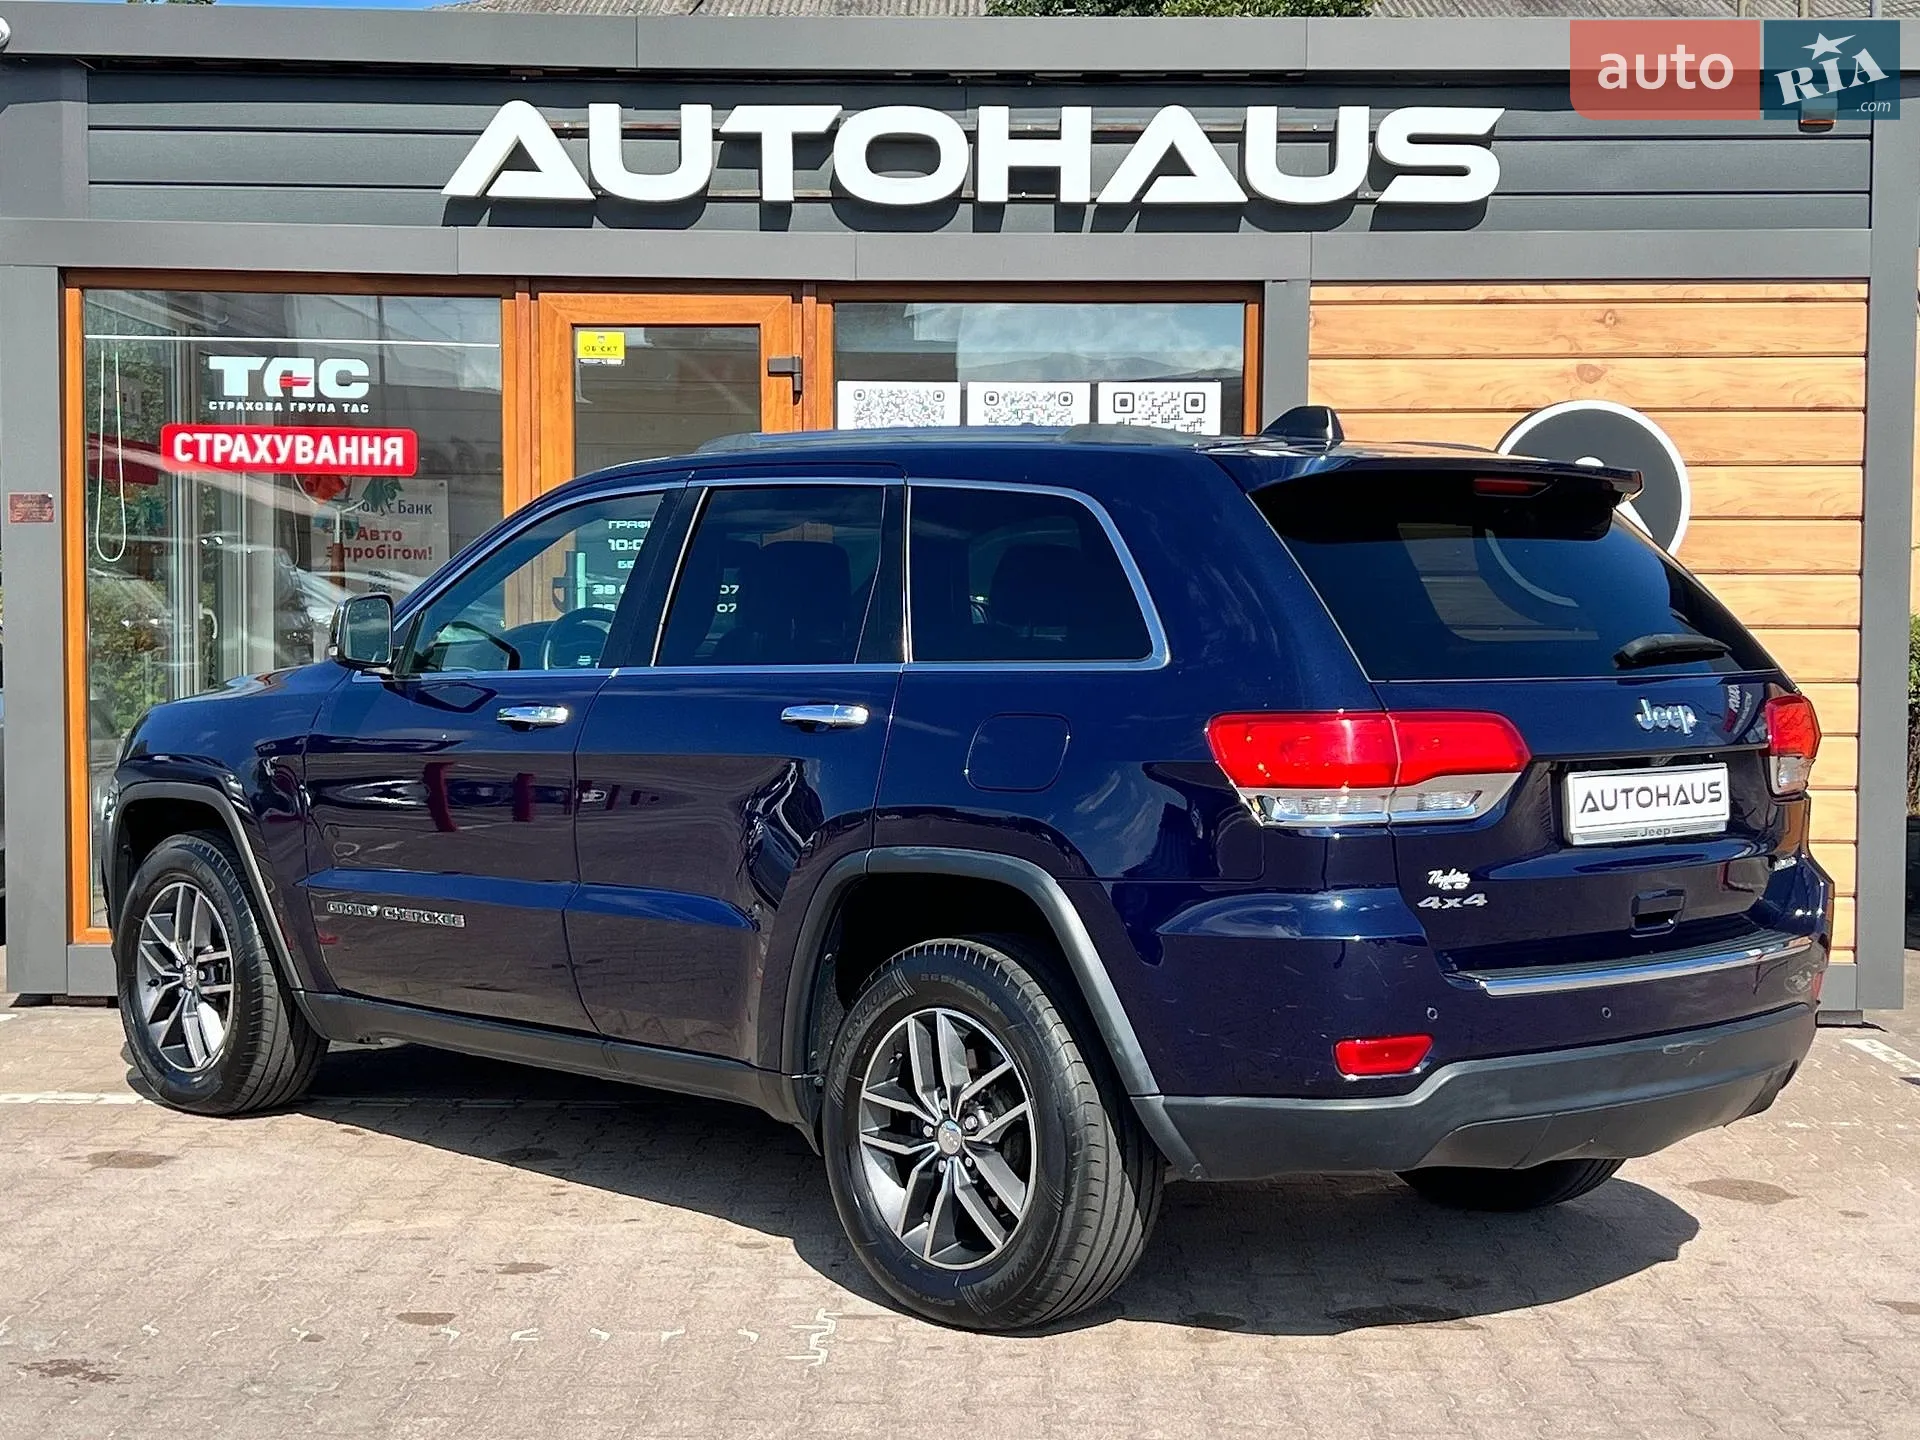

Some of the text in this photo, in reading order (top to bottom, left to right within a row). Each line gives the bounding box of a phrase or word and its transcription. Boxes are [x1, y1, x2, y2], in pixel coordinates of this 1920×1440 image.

[441, 100, 1505, 203] AUTOHAUS
[209, 356, 369, 398] ТАС
[208, 401, 369, 413] СТРАХОВА ГРУПА ТАС
[173, 432, 404, 466] СТРАХУВАННЯ
[398, 501, 433, 515] Банк
[355, 526, 403, 541] Авто
[344, 544, 433, 562] пробігом!
[592, 584, 616, 595] 38
[716, 603, 737, 612] 07
[1635, 696, 1698, 737] Jeep
[1579, 781, 1722, 814] AUTOHAUS
[1640, 826, 1671, 838] Jeep
[382, 906, 466, 928] CHEROKEE
